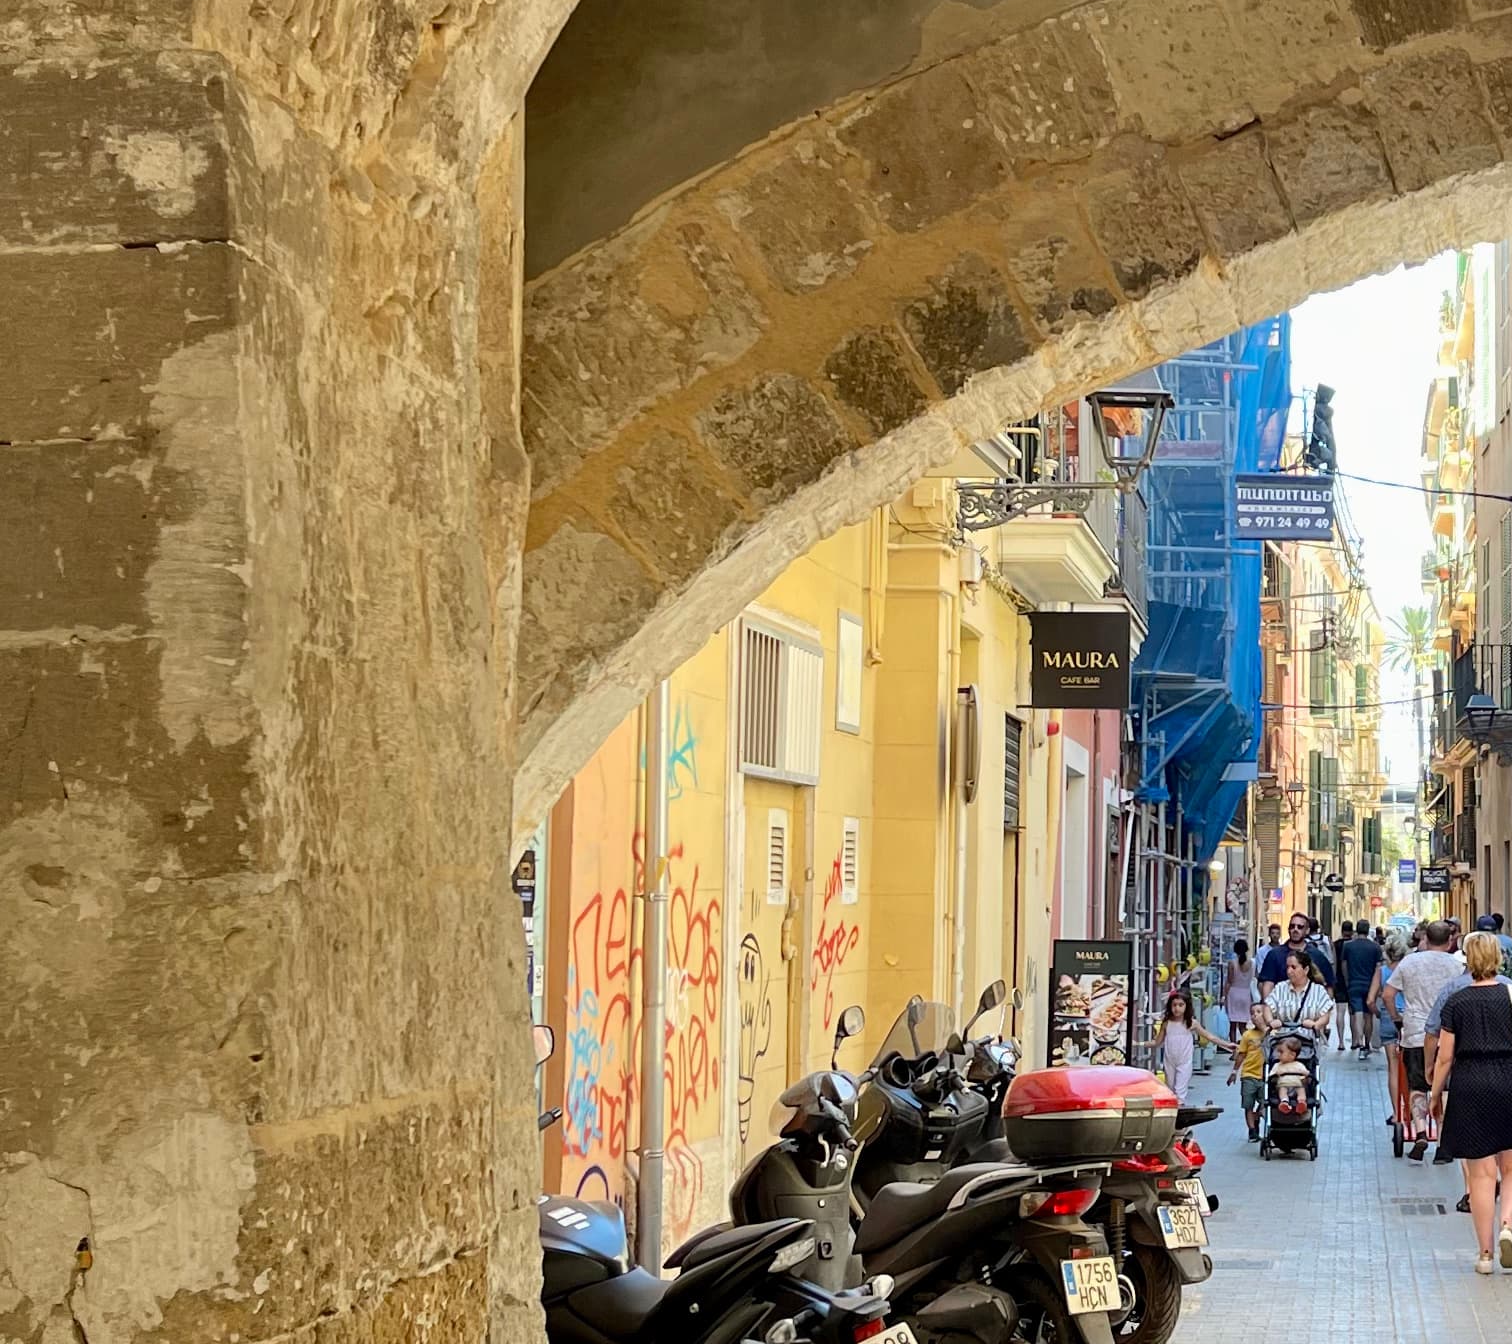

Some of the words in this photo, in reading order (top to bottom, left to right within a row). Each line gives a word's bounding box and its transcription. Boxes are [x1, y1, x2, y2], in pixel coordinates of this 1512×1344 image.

[1255, 516, 1275, 527] 971
[1277, 517, 1292, 527] 24
[1296, 517, 1311, 528] 49
[1315, 518, 1330, 529] 49
[1042, 651, 1119, 669] MAURA
[1060, 676, 1082, 685] CAFE
[1083, 676, 1101, 685] BAR
[1075, 951, 1109, 961] MAURA
[1170, 1208, 1198, 1225] 3627
[1077, 1262, 1112, 1284] 1756
